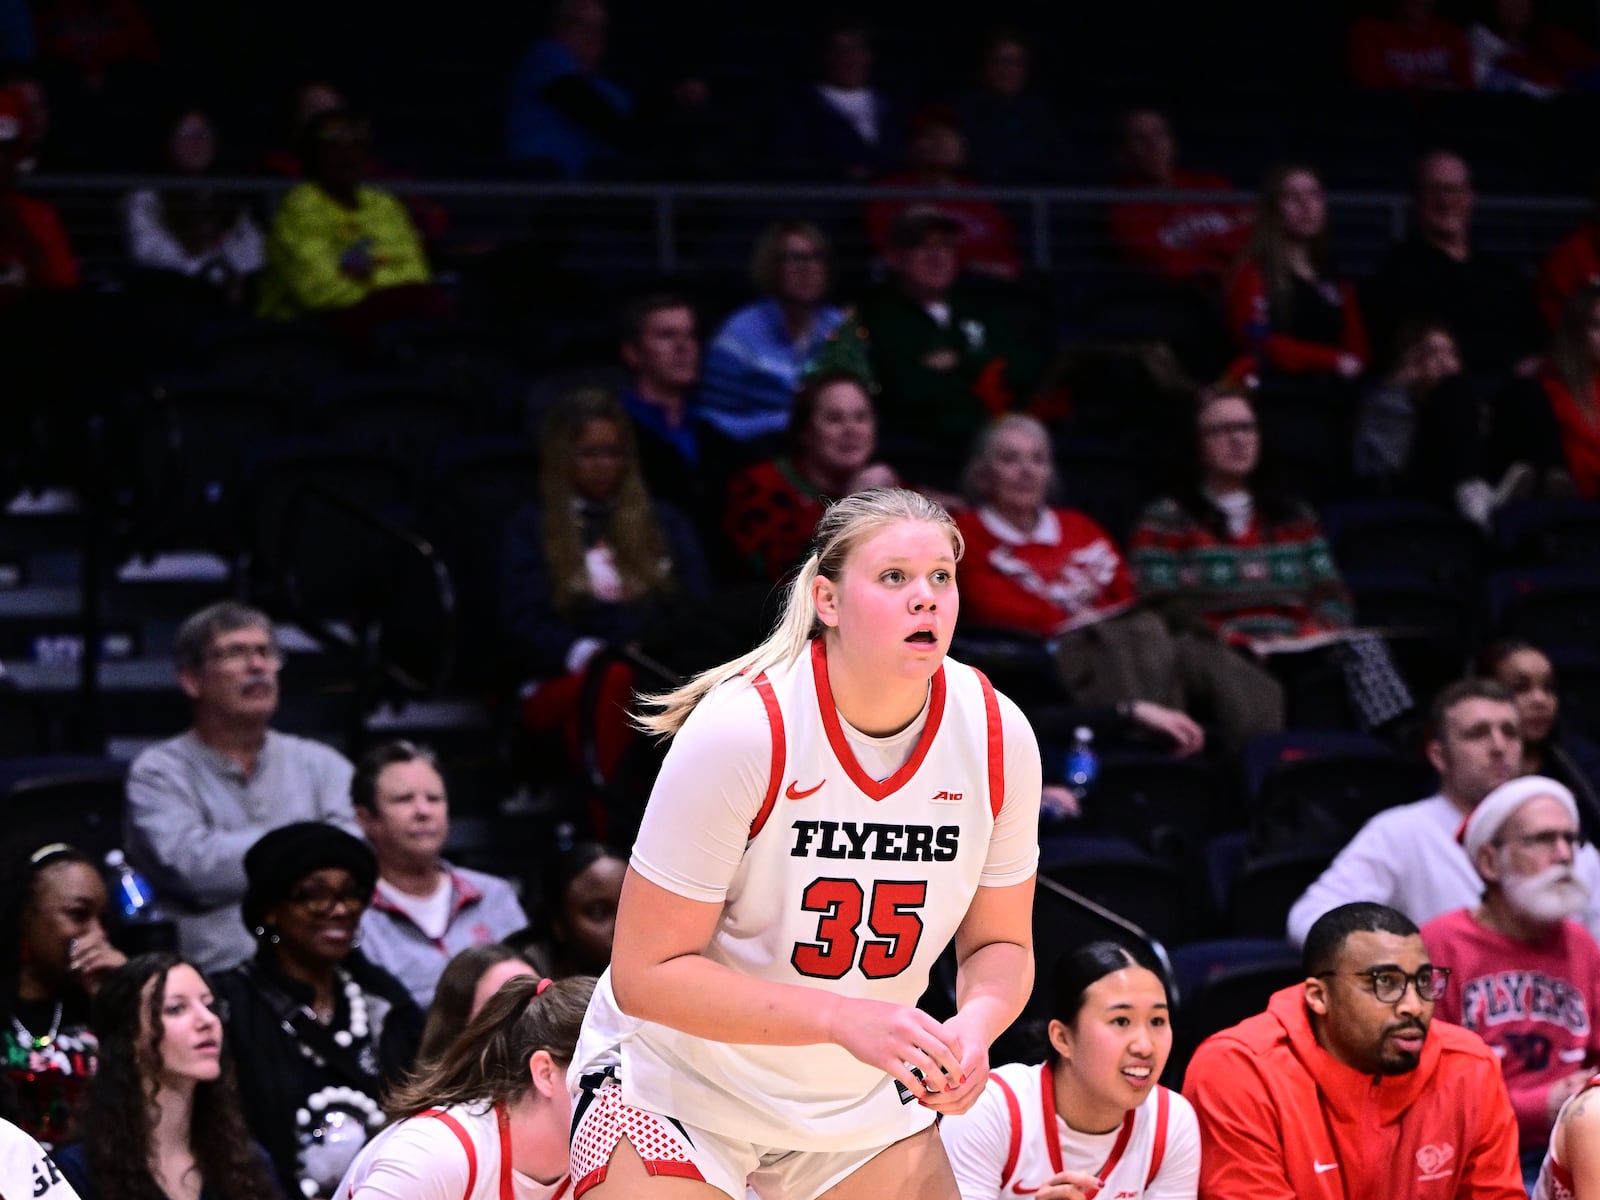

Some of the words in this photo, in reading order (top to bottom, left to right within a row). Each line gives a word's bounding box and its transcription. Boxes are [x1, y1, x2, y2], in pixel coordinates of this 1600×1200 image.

[790, 820, 960, 862] FLYERS
[790, 876, 928, 980] 35
[1461, 970, 1591, 1038] FLYERS
